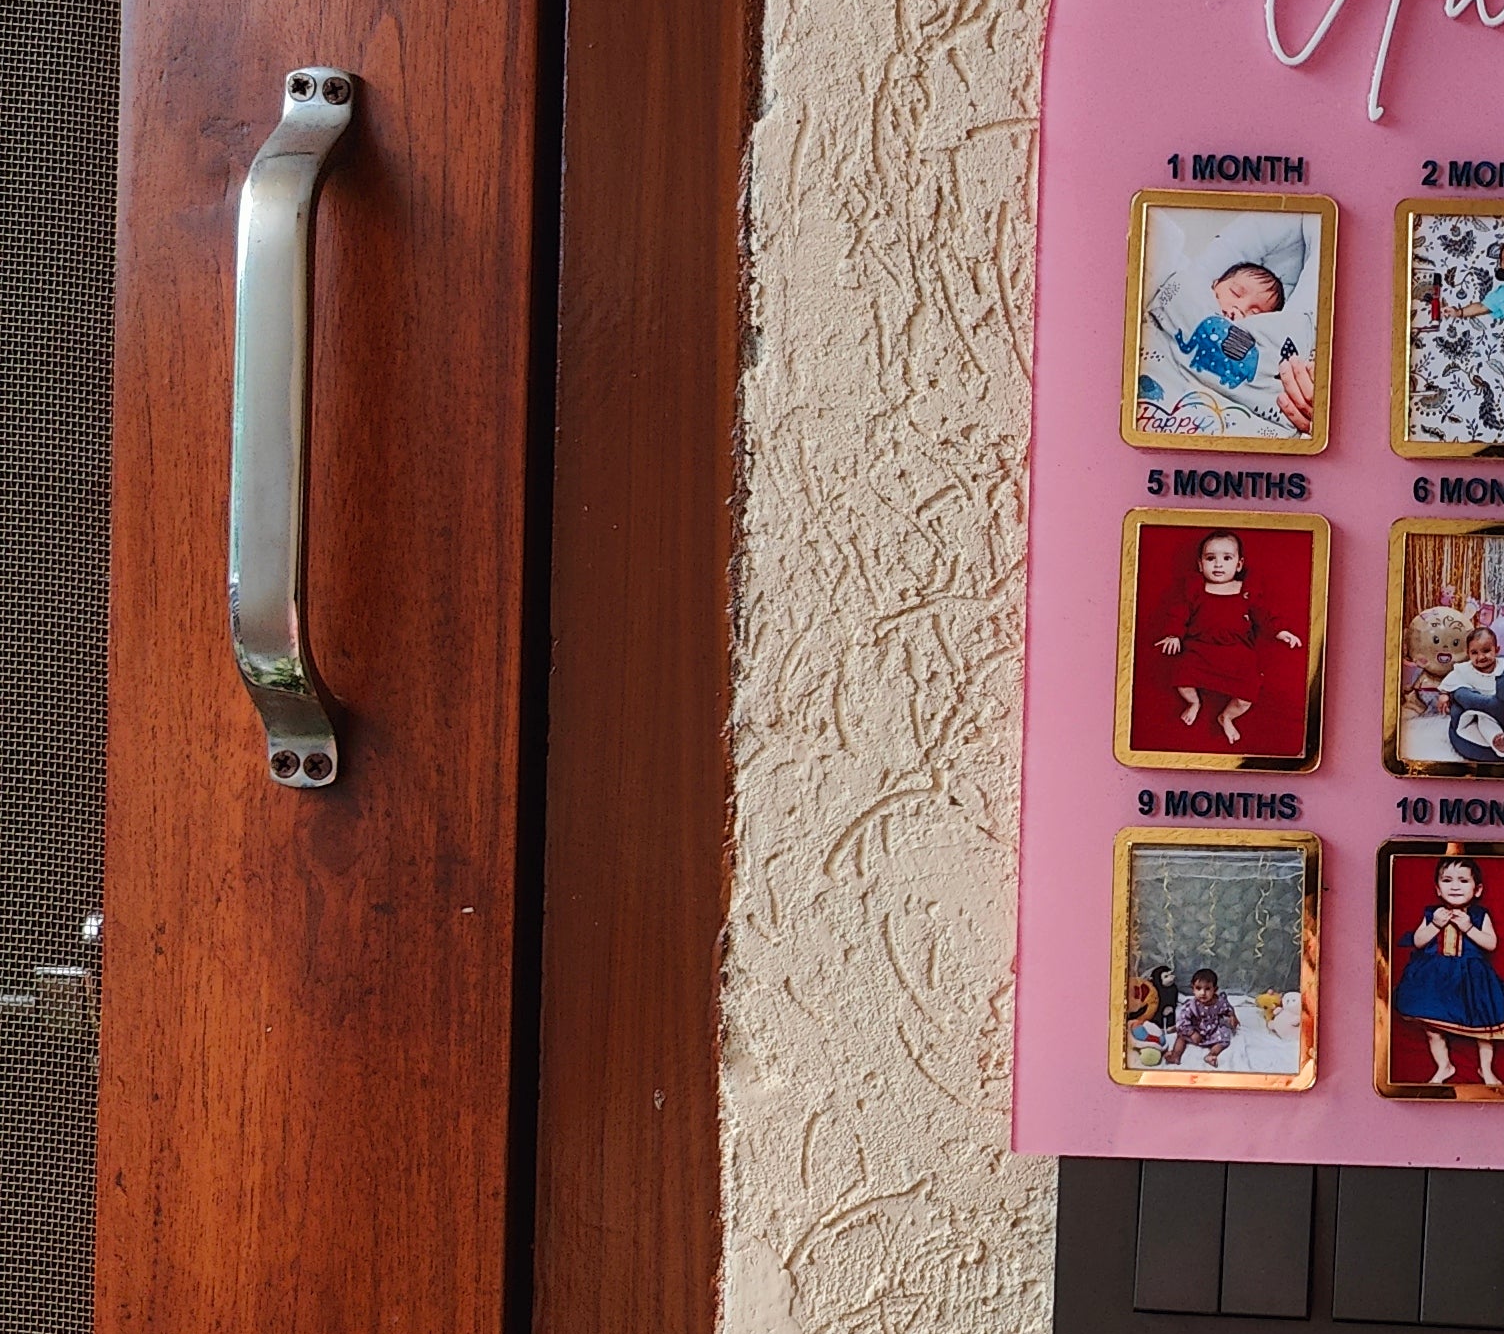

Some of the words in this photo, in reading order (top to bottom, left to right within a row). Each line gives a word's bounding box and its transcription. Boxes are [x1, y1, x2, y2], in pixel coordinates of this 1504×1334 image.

[1168, 154, 1178, 179] 1
[1193, 155, 1303, 182] MONTH
[1422, 161, 1438, 186] 2
[1148, 470, 1164, 494] 5
[1174, 470, 1306, 499] MONTHS
[1414, 477, 1430, 502] 6
[1139, 790, 1154, 815] 9
[1165, 791, 1297, 819] MONTHS
[1397, 797, 1428, 823] 10
